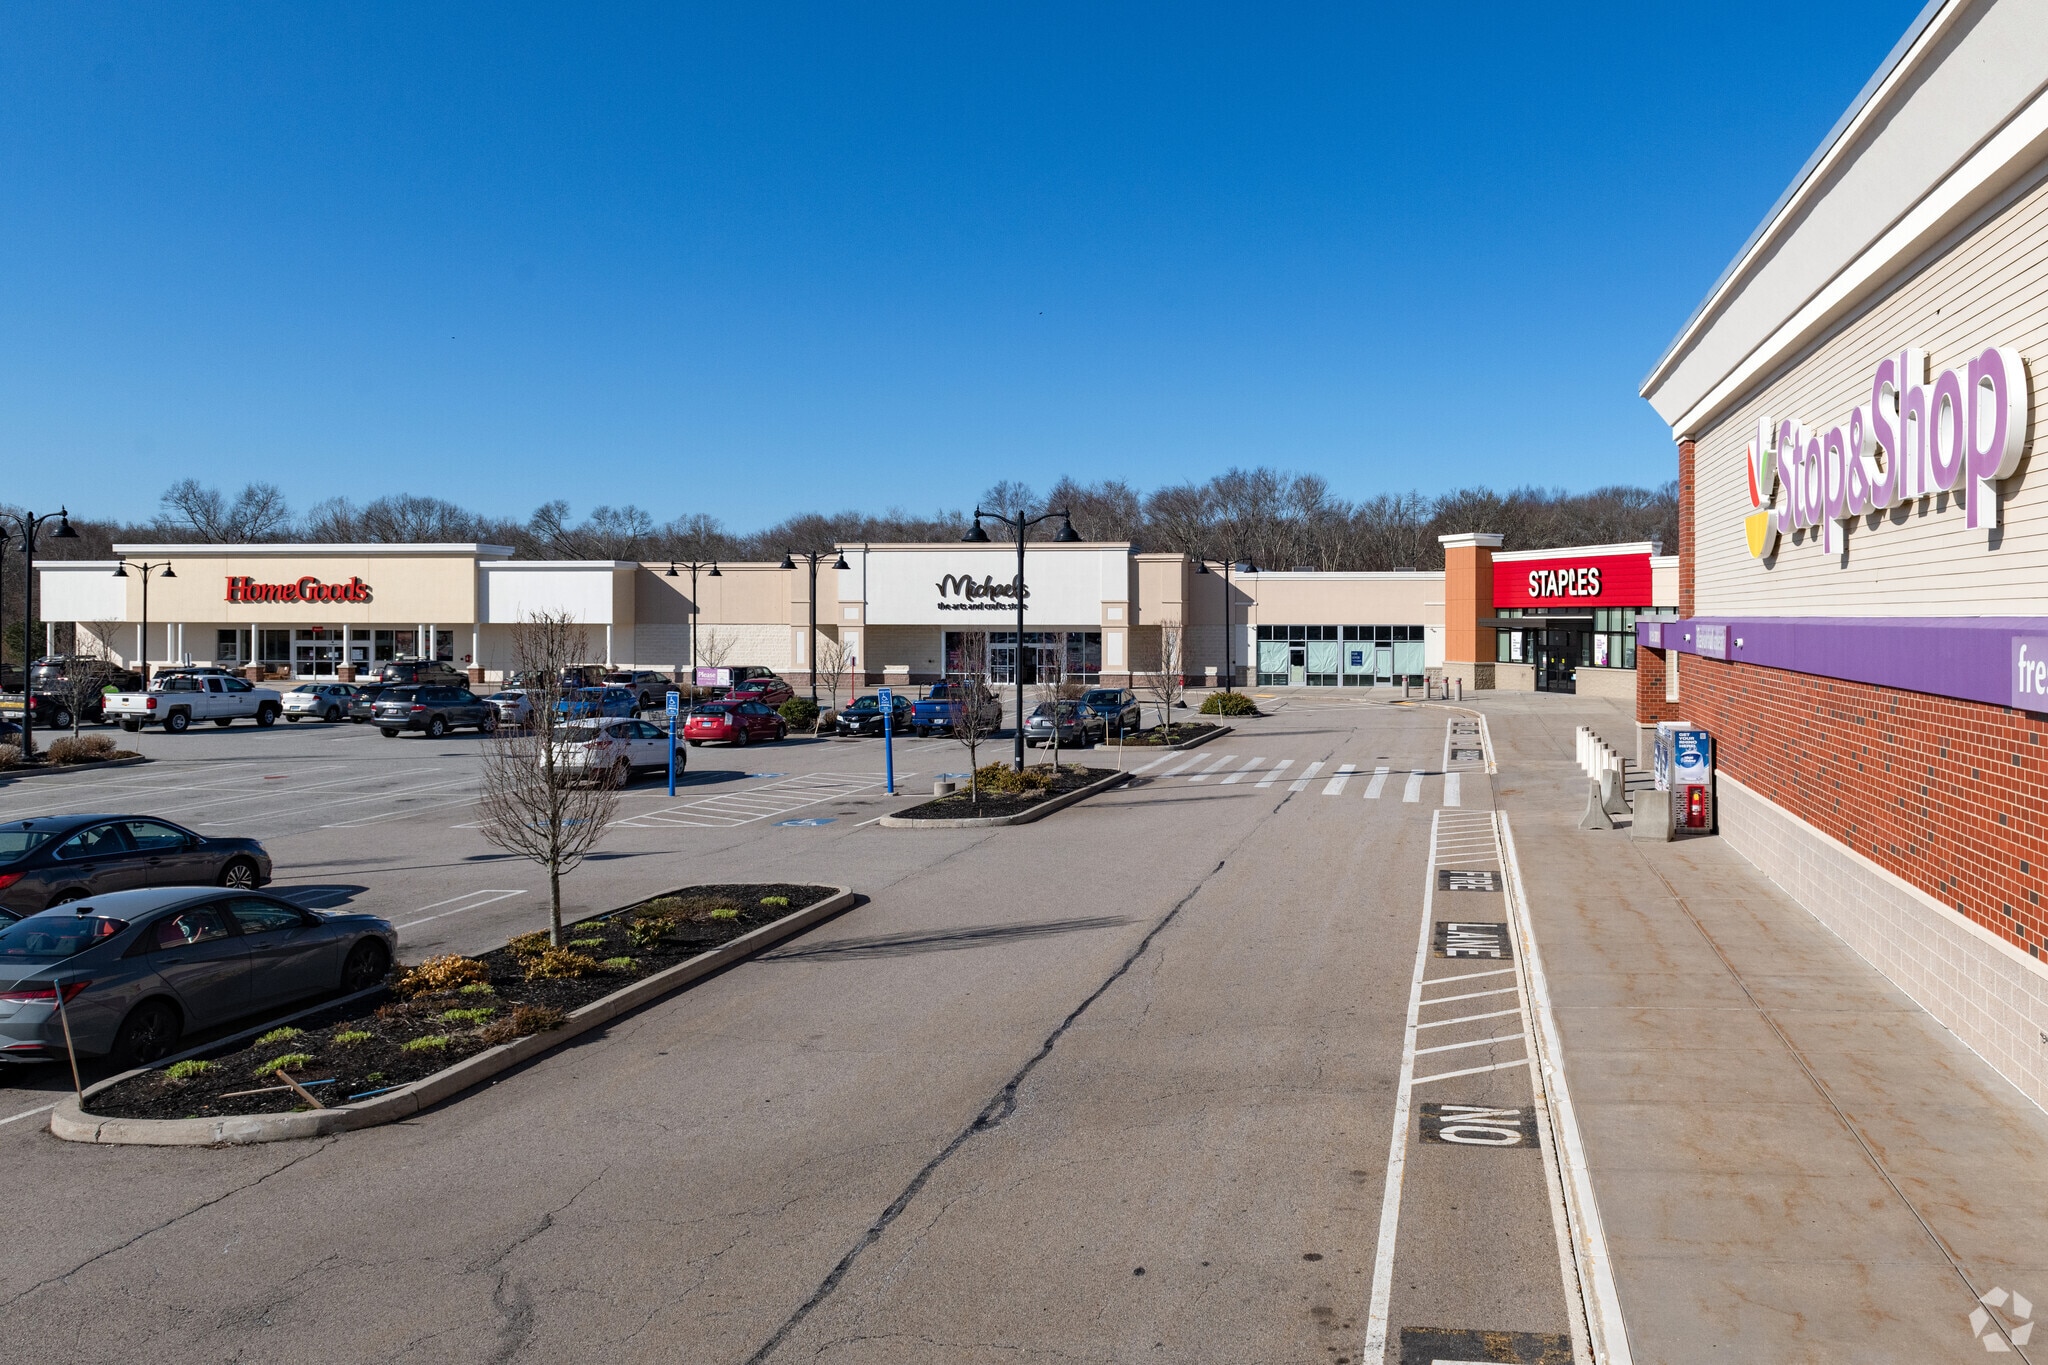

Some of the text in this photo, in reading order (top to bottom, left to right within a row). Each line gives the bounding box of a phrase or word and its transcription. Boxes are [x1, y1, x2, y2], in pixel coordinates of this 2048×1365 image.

[1776, 345, 2014, 556] Stop&Shop
[224, 575, 368, 601] HomeGoods
[1528, 567, 1600, 597] STAPLES
[937, 602, 951, 610] the
[952, 602, 968, 610] arts
[968, 602, 984, 610] and
[984, 602, 1006, 610] crafts
[2017, 643, 2048, 695] fre
[1446, 870, 1500, 958] FIRE LANE
[1439, 1105, 1522, 1146] NO
